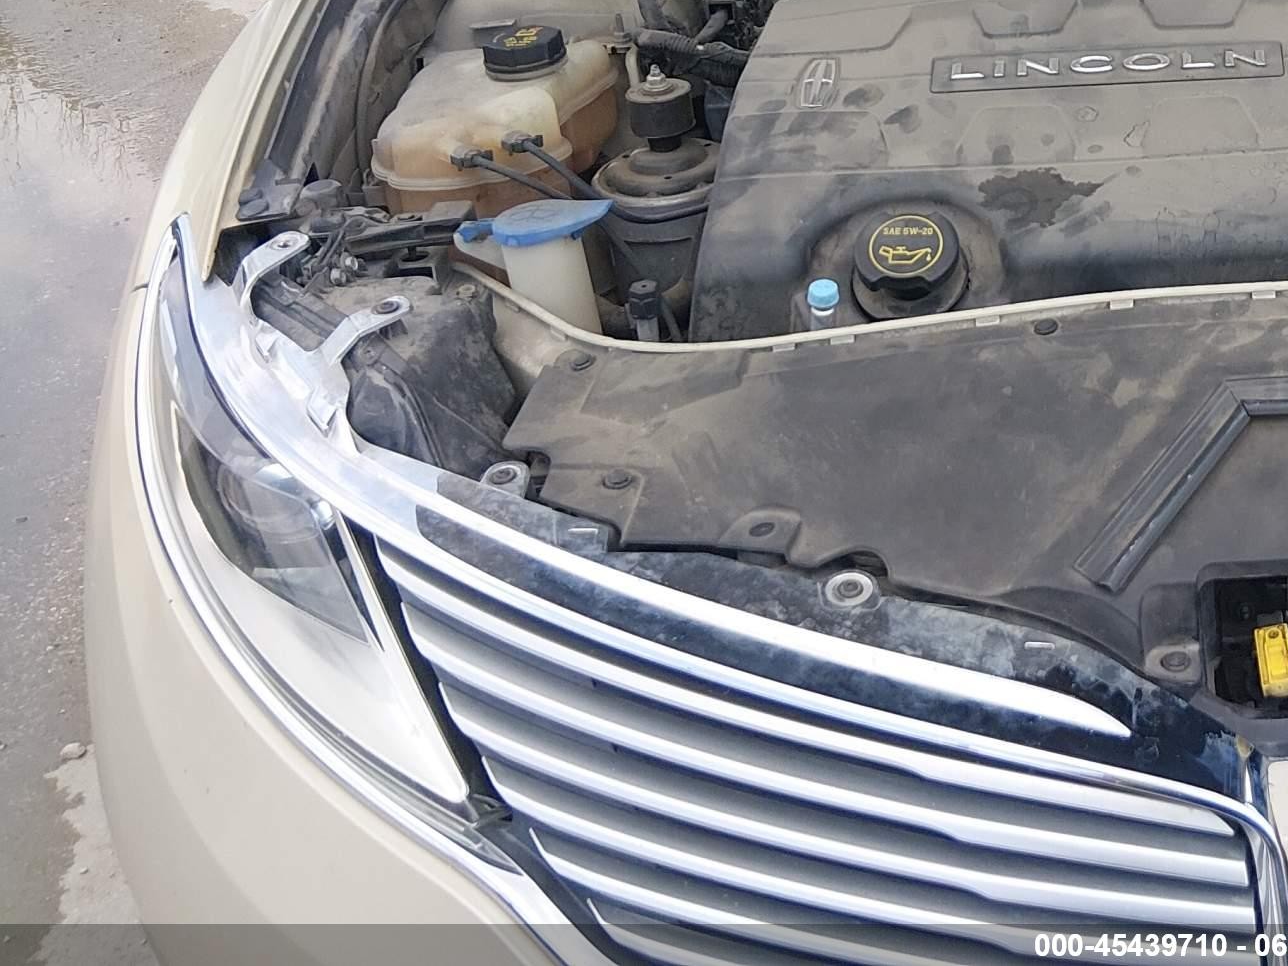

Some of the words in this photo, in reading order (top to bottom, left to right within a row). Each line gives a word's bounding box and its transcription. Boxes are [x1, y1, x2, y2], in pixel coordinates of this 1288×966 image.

[949, 48, 1268, 82] LINCOLN
[883, 226, 902, 236] SAE
[903, 226, 934, 236] 5W-20
